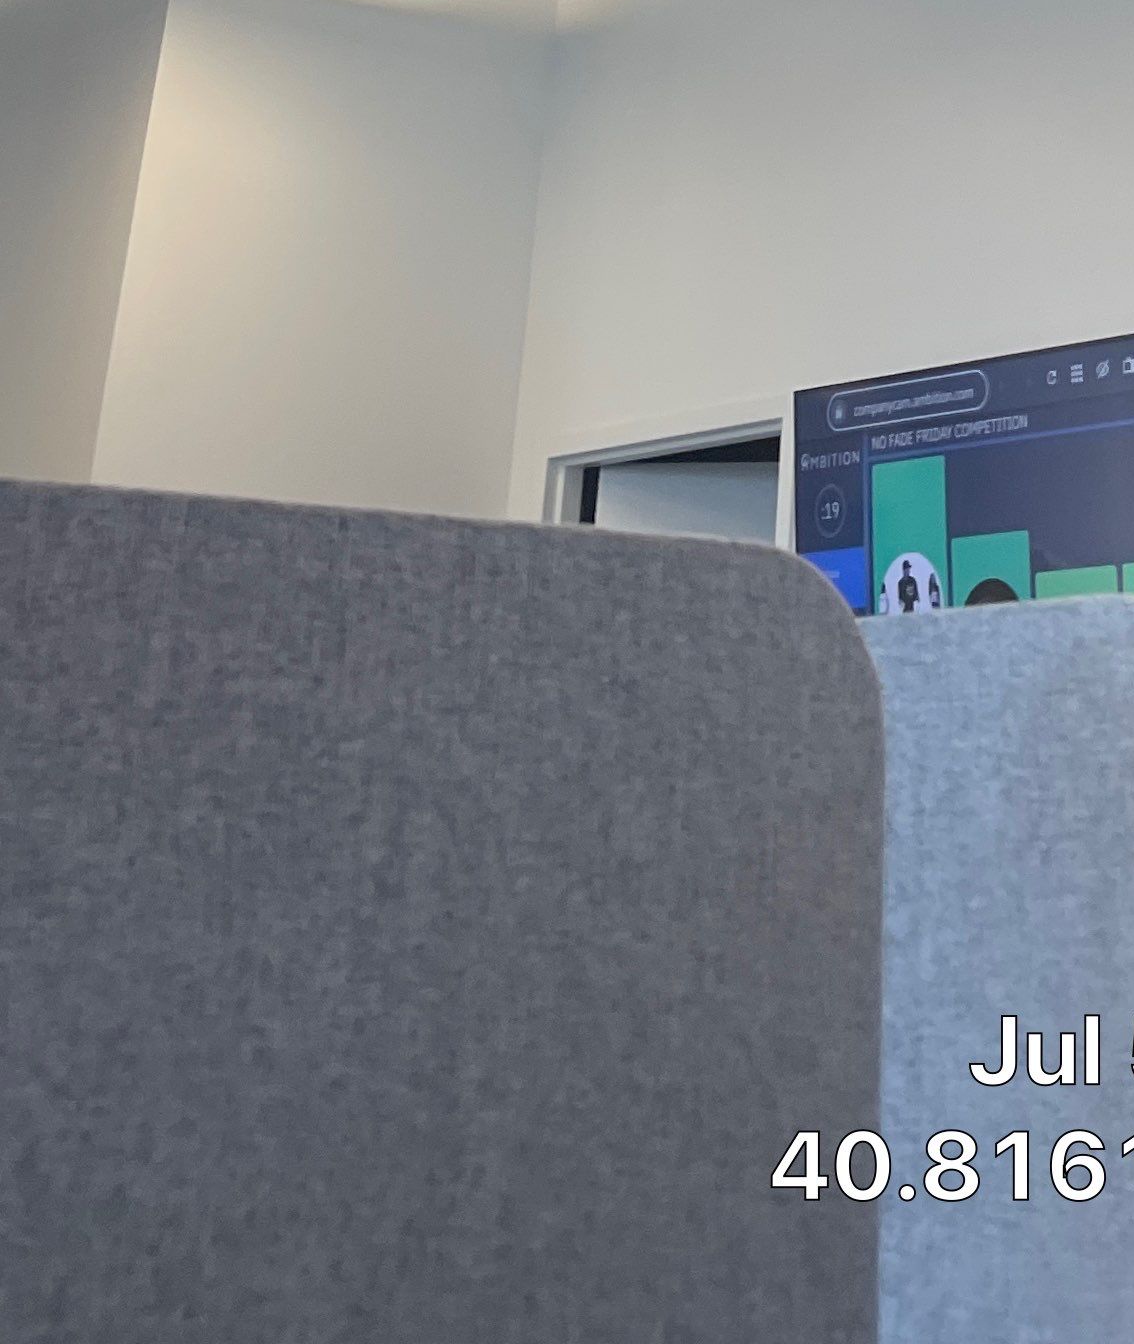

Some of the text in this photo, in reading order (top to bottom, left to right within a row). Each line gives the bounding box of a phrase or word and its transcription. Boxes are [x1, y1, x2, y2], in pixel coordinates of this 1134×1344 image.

[871, 414, 1029, 450] NO FADE FRIDAY COMPETITION
